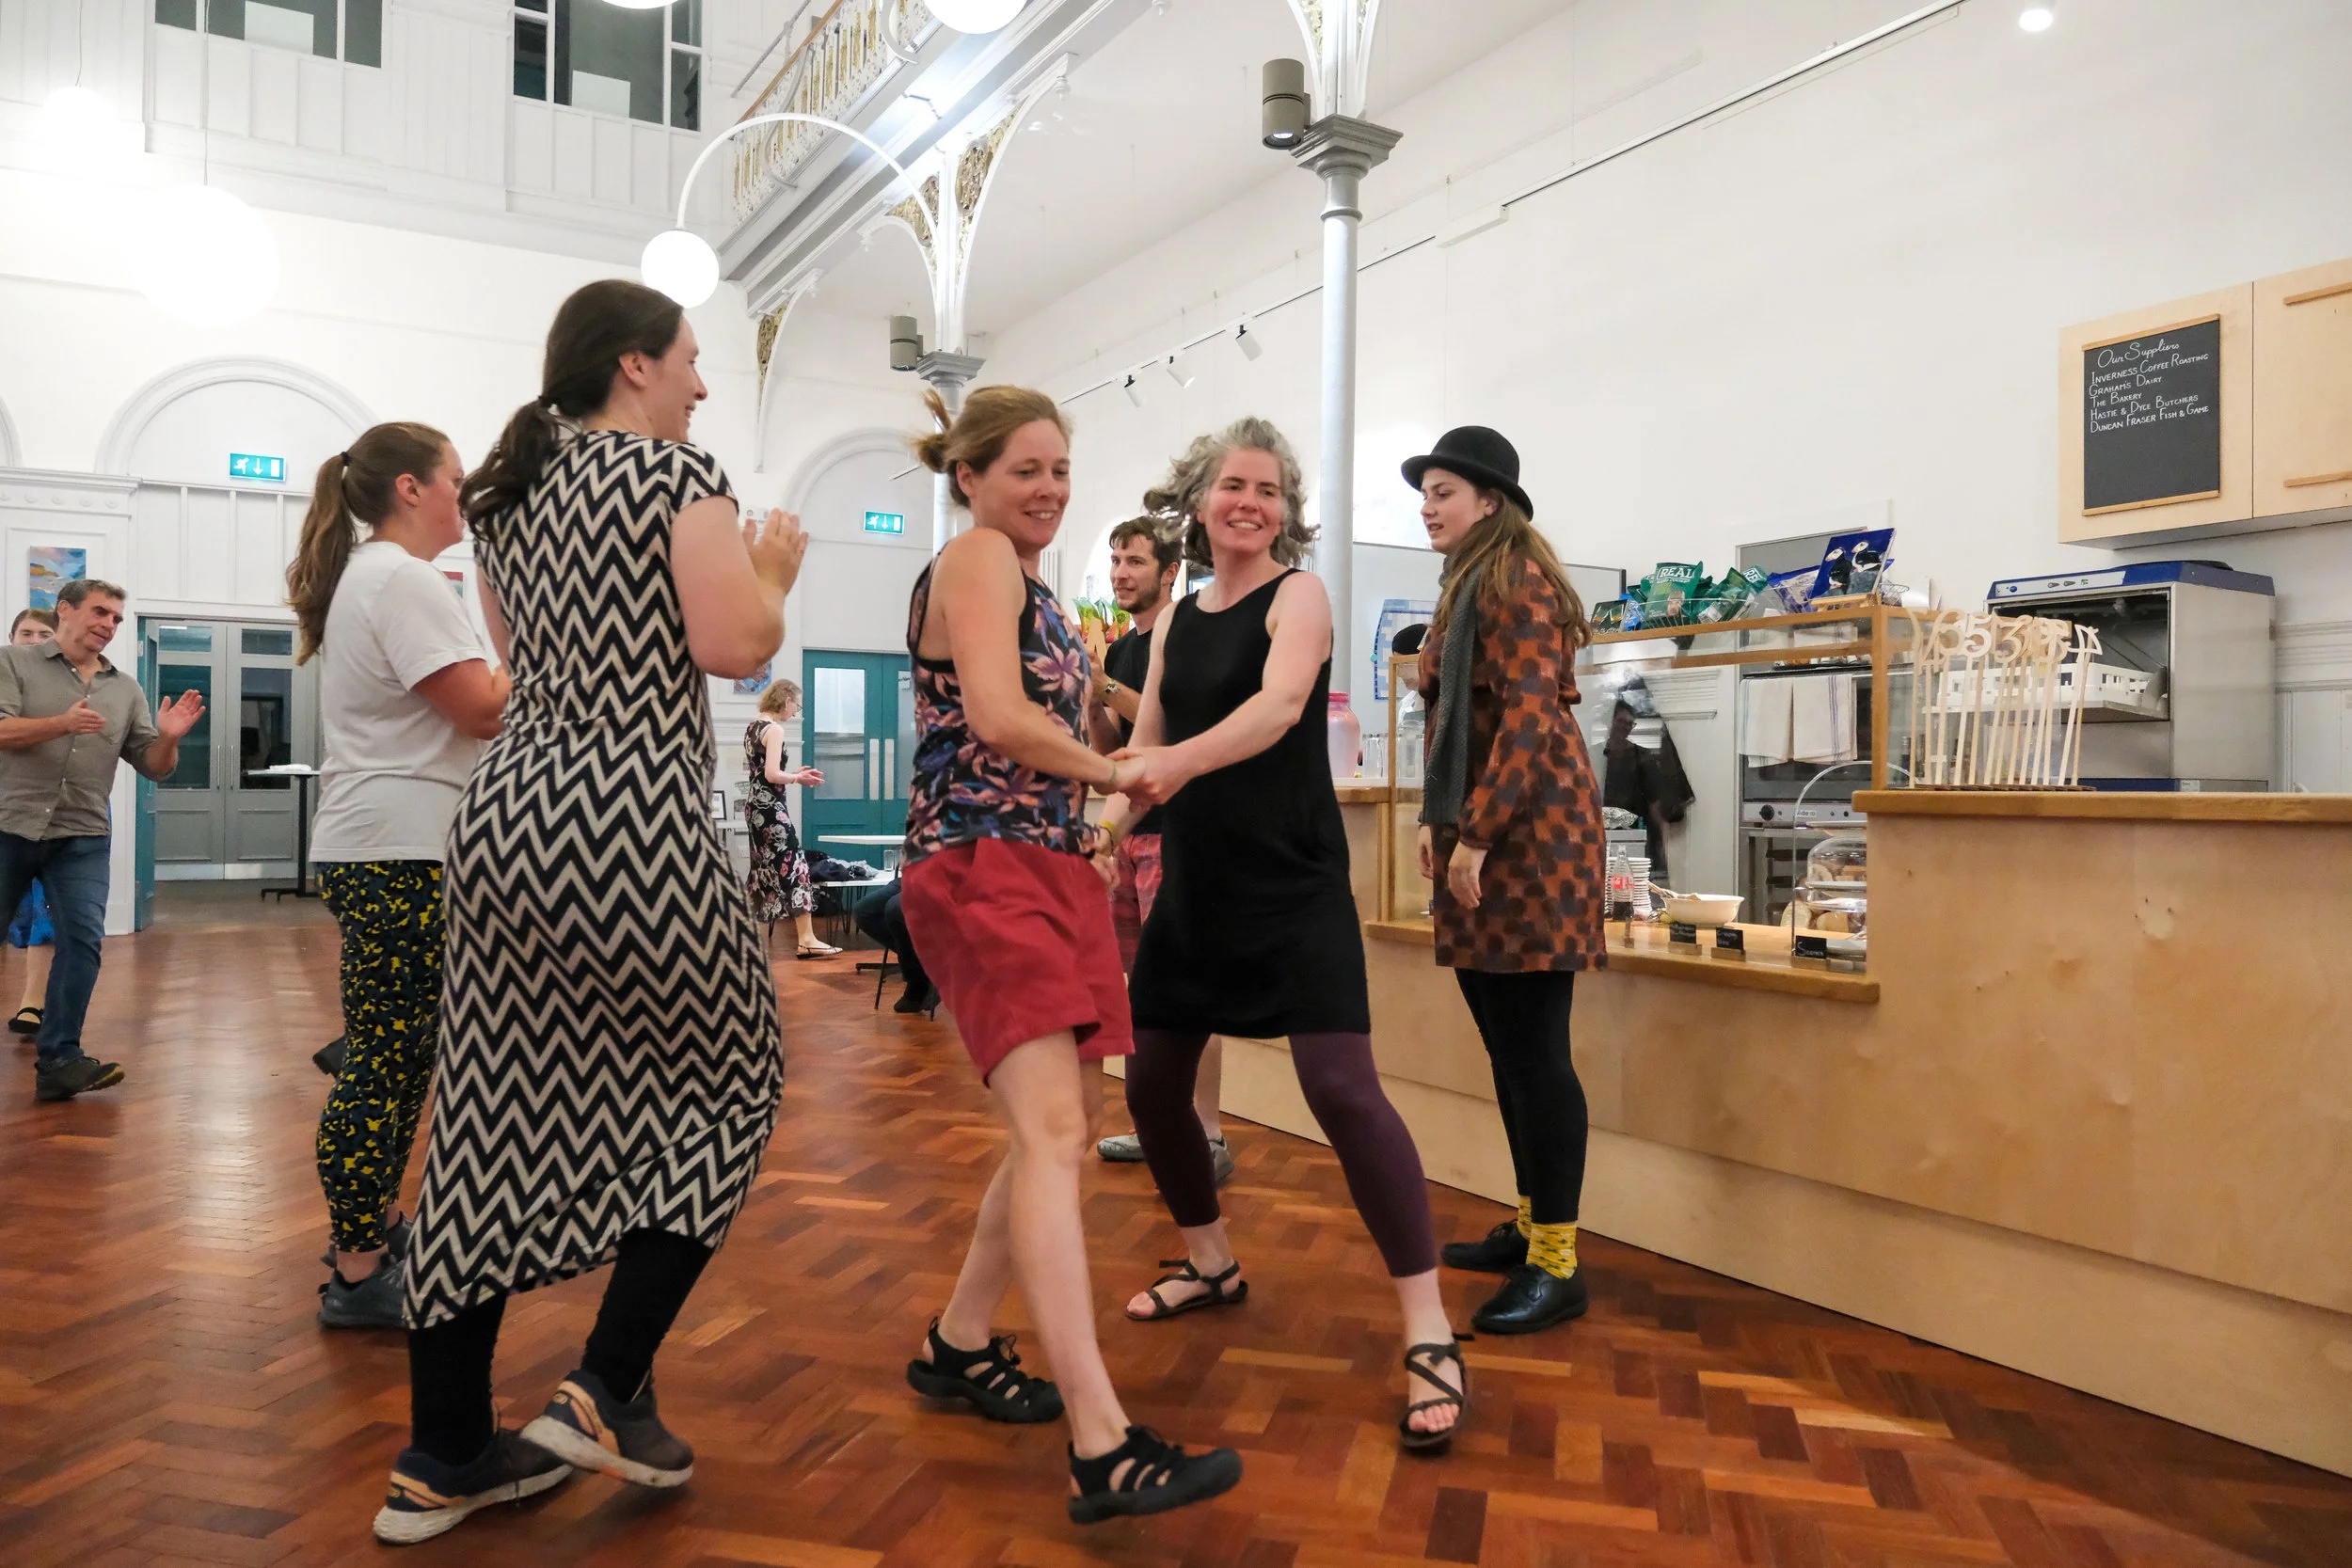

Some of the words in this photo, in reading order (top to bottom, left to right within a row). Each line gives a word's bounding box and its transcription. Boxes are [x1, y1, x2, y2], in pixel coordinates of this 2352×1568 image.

[2097, 349, 2124, 368] Our
[2124, 339, 2180, 360] Suppliers
[2091, 367, 2137, 385] INVERNESS
[2139, 359, 2169, 373] COFFEE
[2170, 353, 2209, 367] ROASTING
[2089, 380, 2132, 396] GRAHAM'S
[2136, 373, 2162, 387] DAIRY
[2090, 396, 2106, 407] THE
[2110, 392, 2142, 404] BAKERY
[2090, 408, 2118, 421] HASTIE
[2130, 401, 2152, 414] DYCE
[2155, 395, 2199, 409] BUTCHERS
[2090, 420, 2123, 433] DUNCAN
[2126, 413, 2156, 427] FRASER
[2159, 407, 2177, 420] FISH
[2186, 403, 2209, 415] GAME
[1661, 566, 1692, 578] REAL
